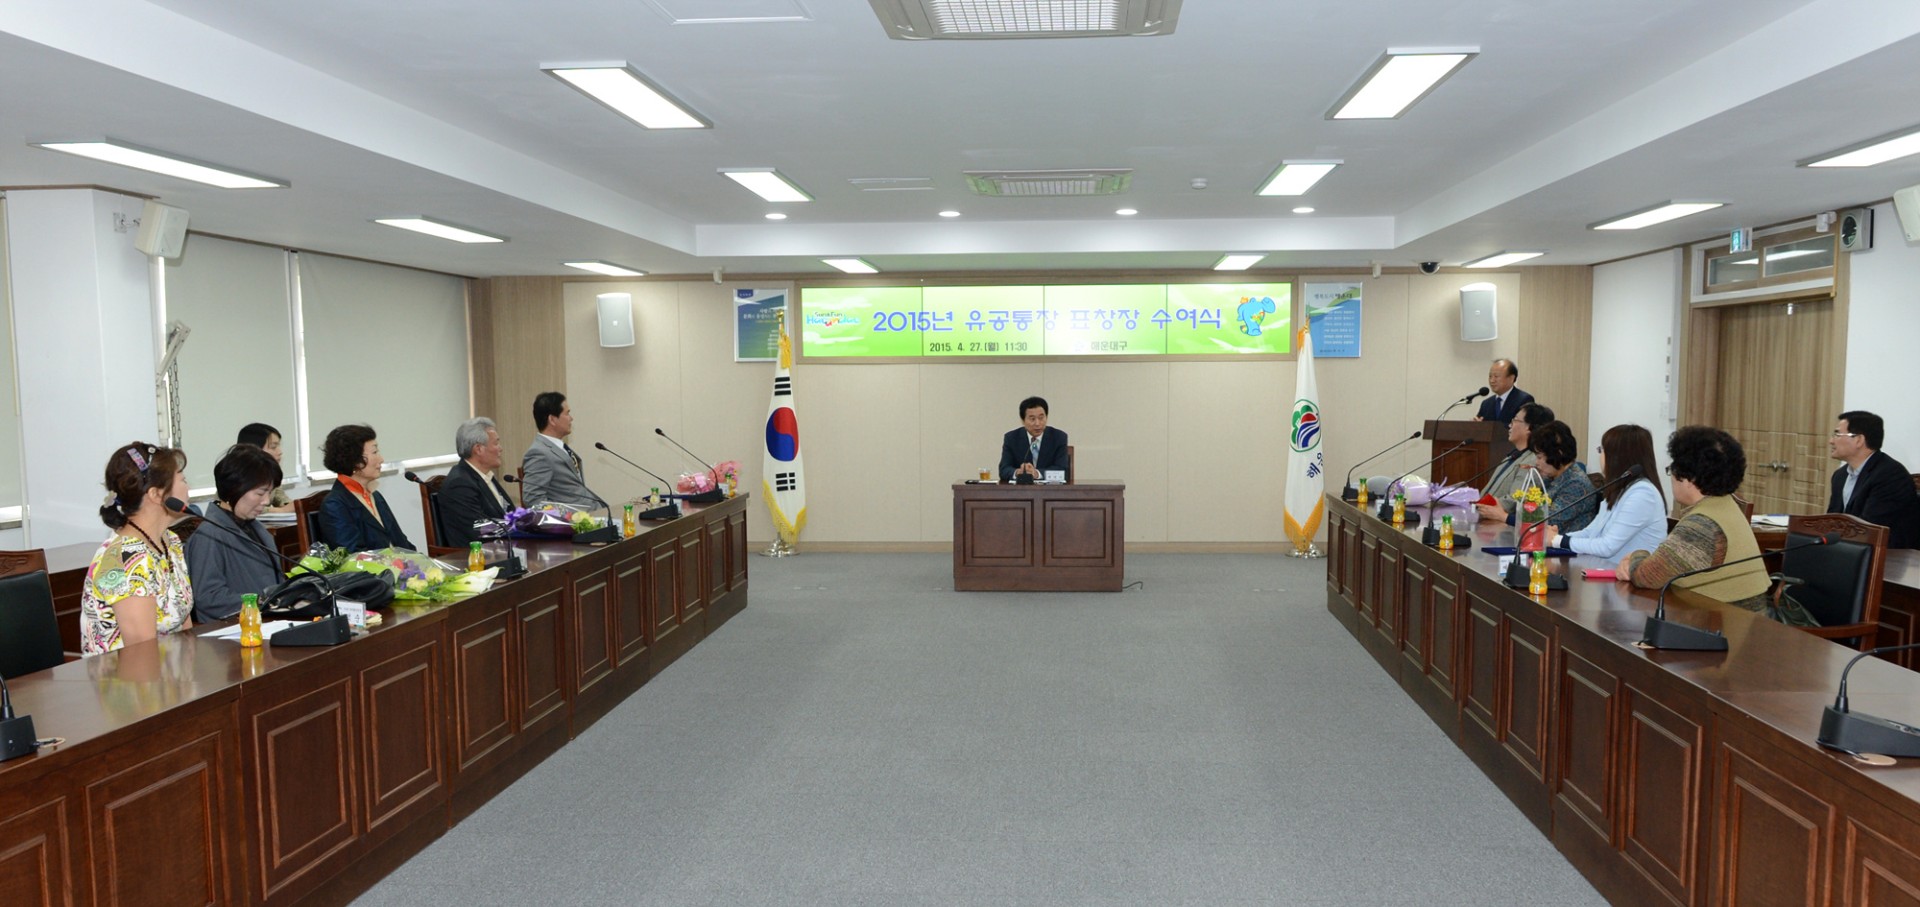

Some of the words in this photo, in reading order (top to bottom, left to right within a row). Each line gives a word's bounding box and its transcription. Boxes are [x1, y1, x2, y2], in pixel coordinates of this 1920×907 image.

[872, 310, 953, 332] 2015년
[965, 310, 1060, 332] 유공통장
[1070, 309, 1140, 331] 표창장
[1151, 308, 1222, 330] 수여식
[929, 342, 952, 352] 2015.
[1005, 342, 1028, 352] 11:30
